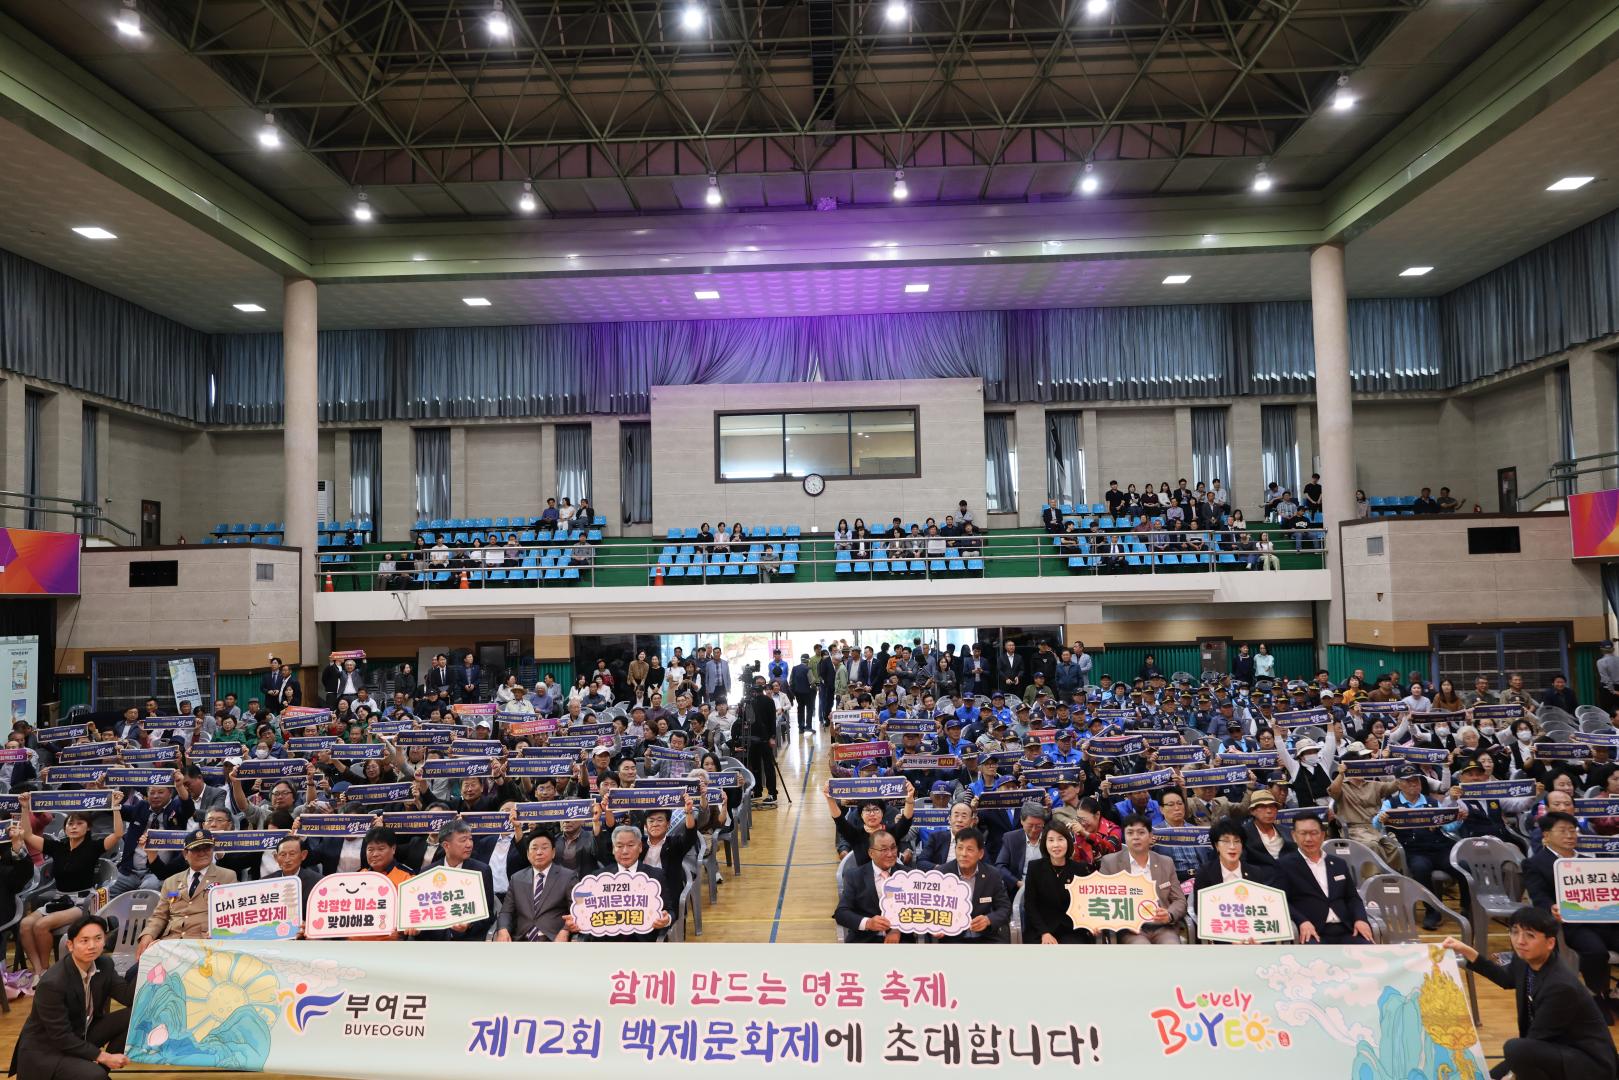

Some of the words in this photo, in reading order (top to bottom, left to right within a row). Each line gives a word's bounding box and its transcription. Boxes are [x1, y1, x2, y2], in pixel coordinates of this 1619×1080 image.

[282, 766, 304, 776] 성공기원
[466, 764, 488, 775] 성공기원
[549, 764, 570, 774] 성공기원
[150, 774, 171, 784] 성공기원
[1151, 773, 1170, 784] 성공기원
[1226, 771, 1246, 782] 성공기원
[388, 790, 410, 800] 성공기원
[878, 783, 904, 796] 성공기원
[1508, 786, 1532, 797] 성공기원
[82, 797, 108, 808] 성공기원
[656, 794, 680, 806] 성공기원
[566, 806, 590, 818] 성공기원
[346, 822, 372, 833] 성공기원
[1563, 874, 1584, 886] 다시
[1586, 873, 1608, 884] 찾고
[1611, 873, 1619, 884] 싶
[602, 883, 630, 892] 제72회
[913, 882, 940, 891] 제72회
[1078, 885, 1127, 895] 바가지요금
[417, 890, 464, 906] 안전하고
[584, 894, 648, 908] 백제문화제
[894, 893, 958, 909] 백제문화제
[1565, 888, 1619, 902] 백제문화
[216, 900, 234, 912] 다시
[238, 895, 256, 908] 찾고
[260, 892, 280, 904] 싶은
[318, 899, 351, 912] 친절한
[355, 898, 386, 910] 미소로
[1088, 897, 1134, 920] 축제
[216, 906, 287, 928] 백제문화제
[410, 906, 446, 924] 즐거운
[450, 902, 476, 916] 축제
[898, 907, 953, 927] 성공기원
[1219, 904, 1268, 917] 안전하고
[328, 914, 374, 928] 맞이해요
[590, 909, 644, 927] 성공기원
[1211, 919, 1249, 933] 즐거운
[1254, 919, 1280, 933] 축제
[610, 970, 675, 1005] 함께
[691, 970, 787, 1004] 만드는
[803, 972, 864, 1007] 명품
[880, 970, 958, 1009] 축제,
[1176, 987, 1252, 1012] Lovely
[346, 994, 426, 1020] 부여군
[345, 1024, 424, 1036] BUYEOGUN
[469, 1016, 600, 1058] 제72회
[622, 1019, 862, 1063] 백제문화제에
[884, 1022, 1100, 1065] 초대합니다!
